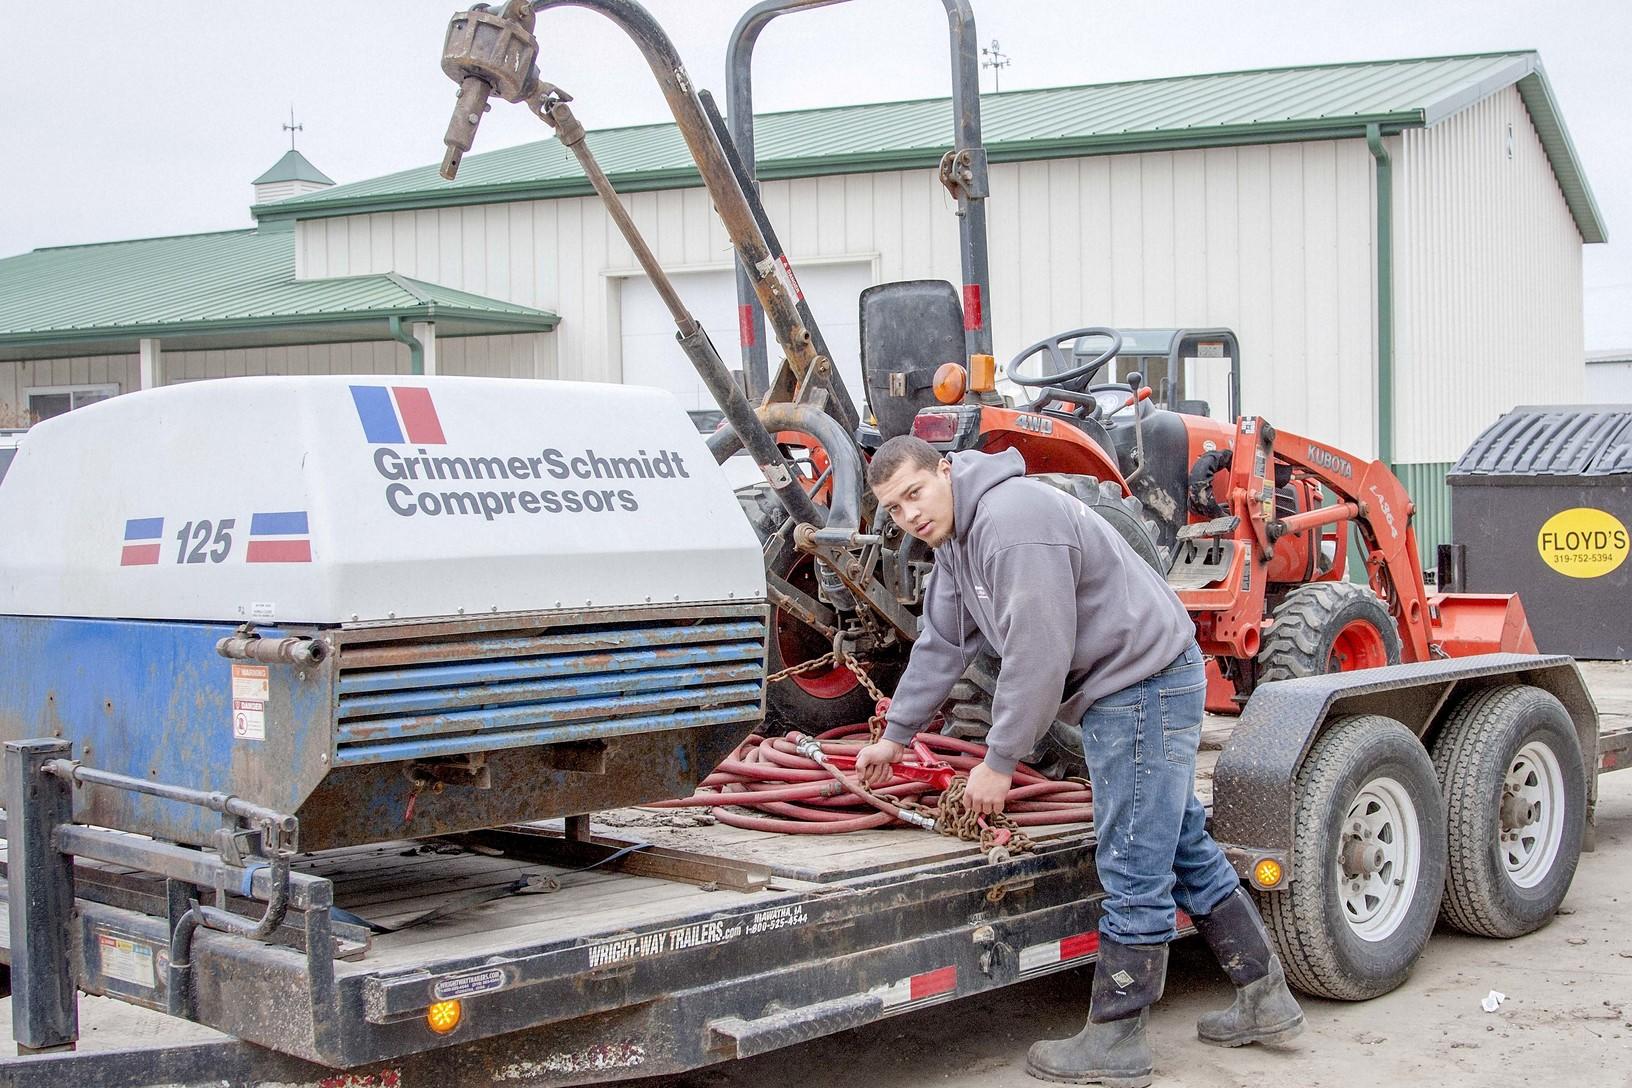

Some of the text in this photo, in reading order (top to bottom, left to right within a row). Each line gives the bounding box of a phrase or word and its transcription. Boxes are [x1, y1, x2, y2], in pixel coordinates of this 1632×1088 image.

[786, 268, 801, 294] DANGER
[1015, 413, 1053, 434] 4WD
[373, 447, 690, 481] GrimmerSchmidt
[1307, 444, 1353, 479] KUBOTA
[385, 482, 639, 521] Compressors
[1368, 484, 1398, 540] LA364
[176, 518, 236, 564] 125
[1542, 530, 1626, 551] FLOYD'S
[1553, 553, 1613, 564] 319-752-5394
[745, 913, 808, 935] 1-800-525-4544
[588, 933, 667, 968] WRIGHT-WAY
